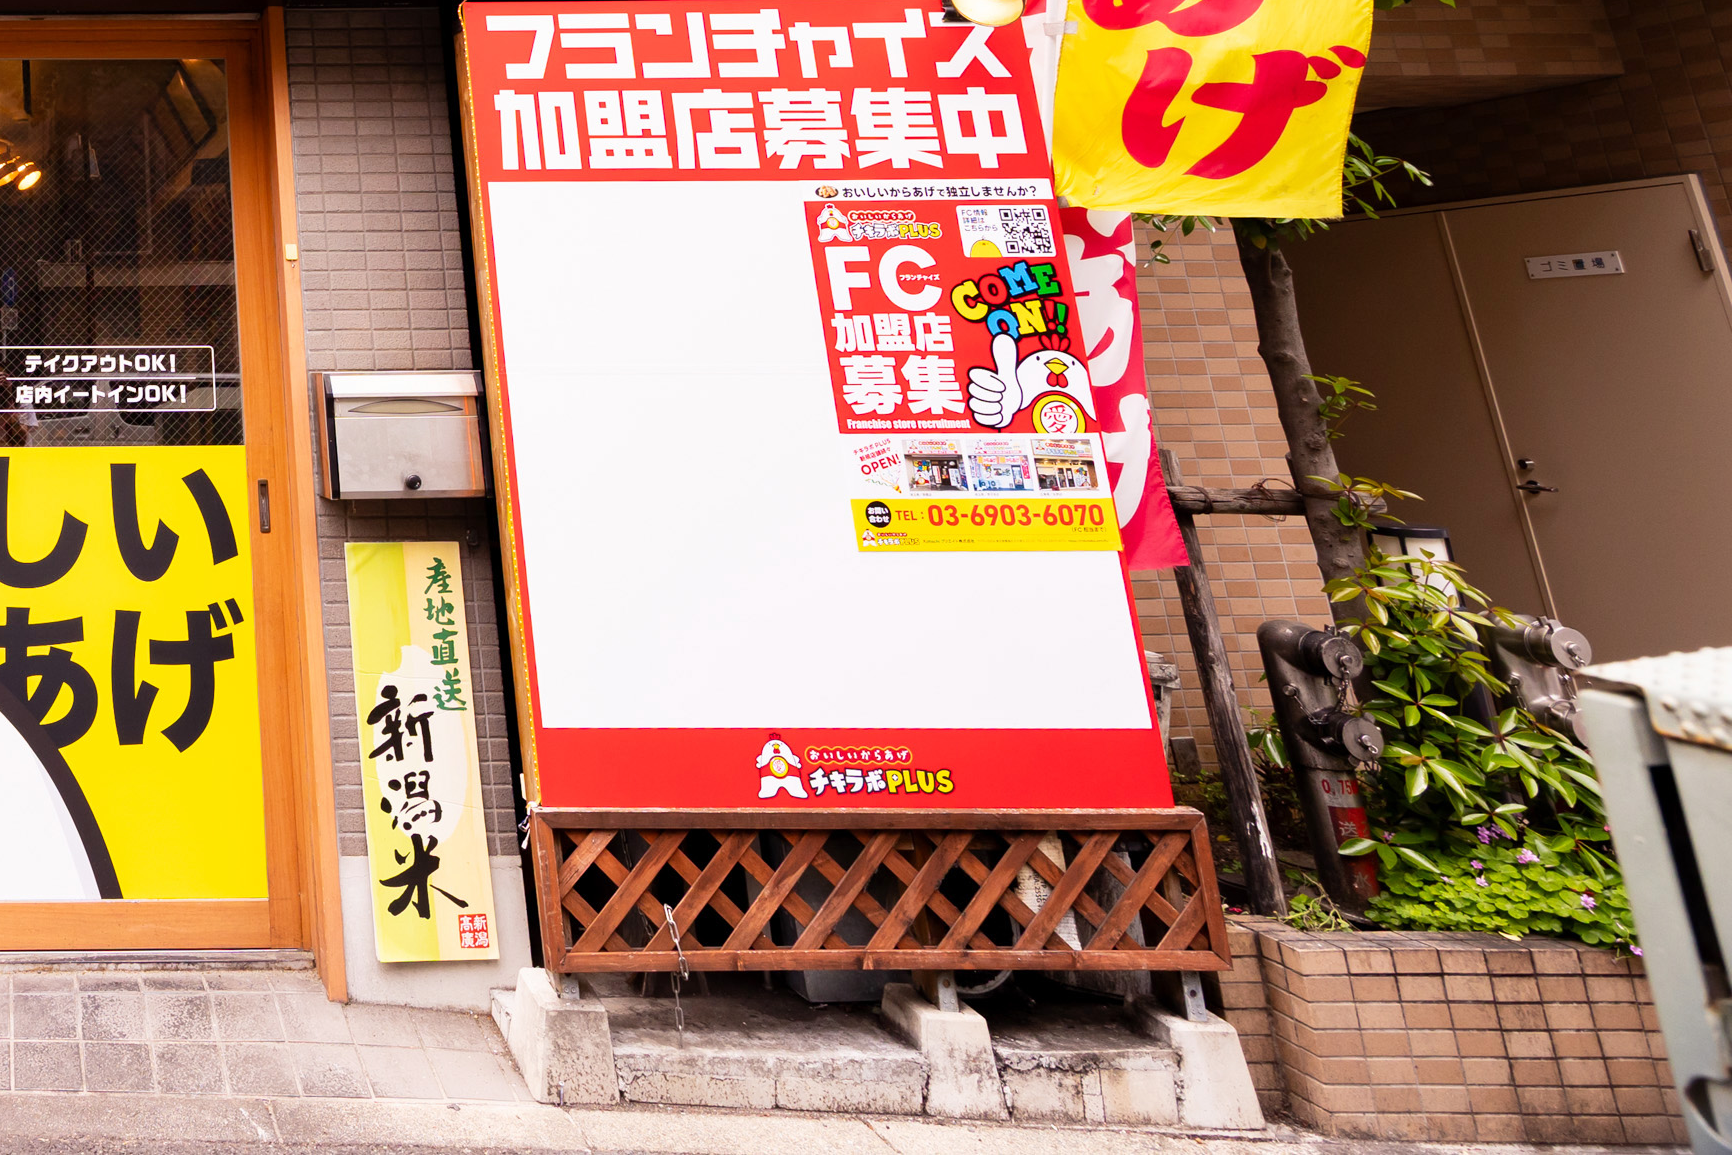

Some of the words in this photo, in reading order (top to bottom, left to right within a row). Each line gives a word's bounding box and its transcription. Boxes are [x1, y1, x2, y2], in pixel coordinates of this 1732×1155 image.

[494, 86, 1029, 172] 加盟店募集中
[849, 223, 942, 240] チキラボPLUS
[824, 244, 943, 312] FC
[899, 273, 941, 281] フランチャイズ
[951, 260, 1063, 323] COME
[830, 311, 955, 353] 加盟店
[24, 354, 177, 373] テイクアウトOK!
[15, 385, 187, 403] 店内イートインOK!
[839, 354, 966, 415] 募集
[847, 418, 891, 430] Franchise
[892, 419, 917, 430] store
[918, 418, 971, 430] recruitment
[860, 453, 902, 475] OPEN!
[927, 503, 1105, 527] 03-6903-6070
[423, 556, 468, 712] 産地直送
[809, 748, 910, 762] おいしいからあげ
[808, 767, 955, 796] チキラボPLUS
[366, 684, 469, 919] 新潟米
